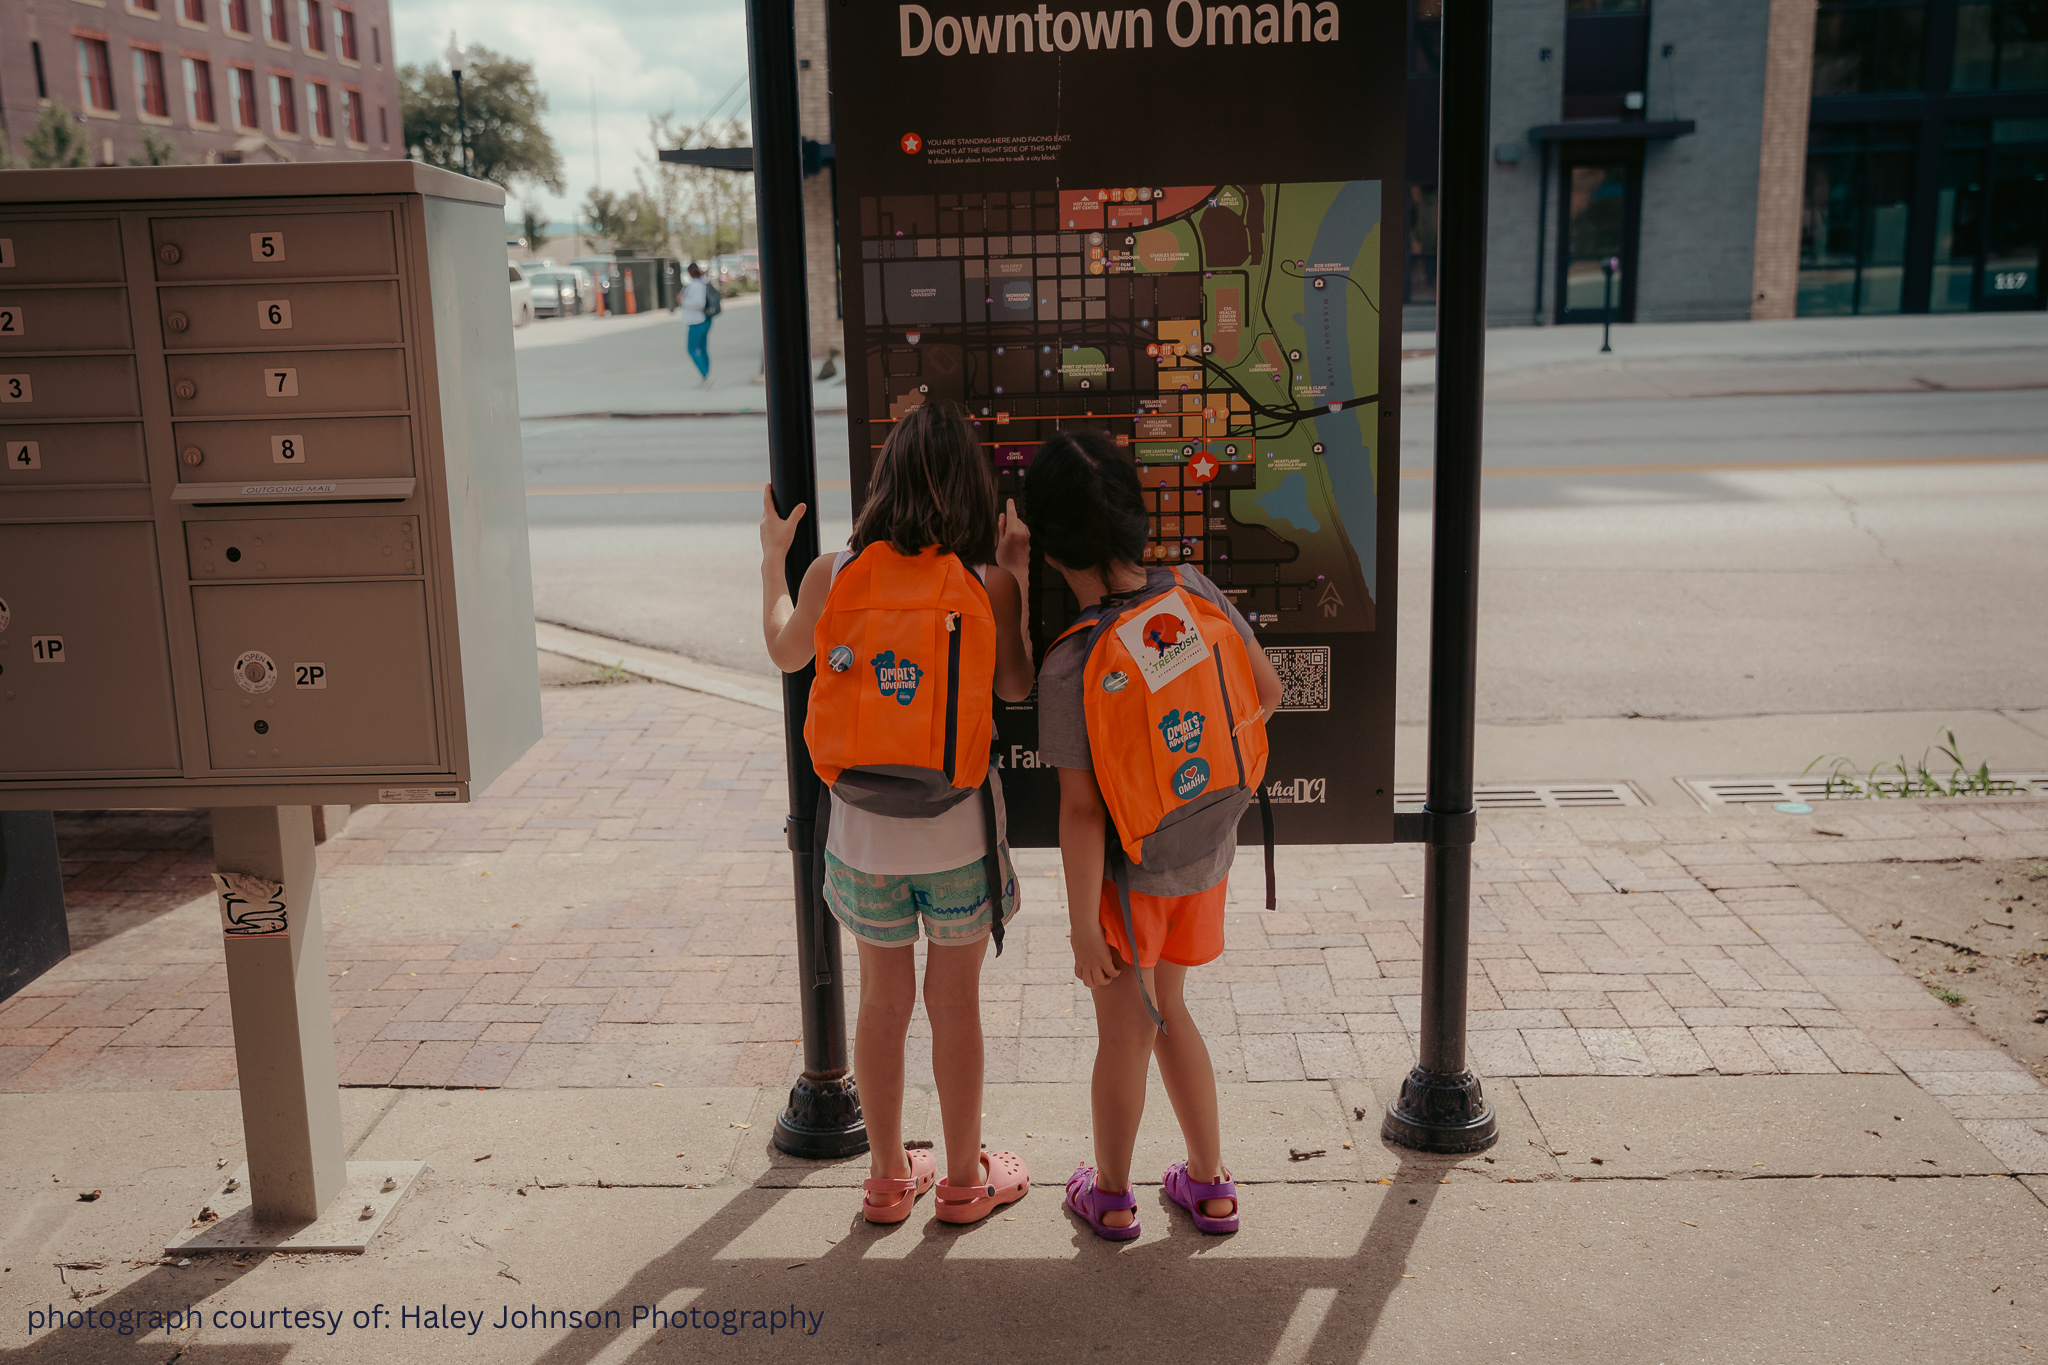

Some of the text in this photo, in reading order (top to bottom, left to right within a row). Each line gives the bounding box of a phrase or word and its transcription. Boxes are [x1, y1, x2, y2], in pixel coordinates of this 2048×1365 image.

[900, 0, 1340, 57] Downtown Omaha
[957, 137, 991, 145] STANDING
[1031, 154, 1041, 163] city
[261, 237, 275, 258] 5
[0, 311, 15, 332] 2
[268, 304, 282, 325] 6
[9, 378, 23, 399] 3
[274, 373, 287, 393] 7
[17, 446, 32, 466] 4
[281, 439, 295, 459] 8
[246, 484, 333, 494] OUTGOING MAIL
[1323, 604, 1338, 618] N
[33, 639, 63, 659] 1P
[243, 653, 266, 663] OPEN
[1152, 633, 1199, 672] TREERUSH
[296, 666, 324, 685] 2P
[880, 680, 916, 690] ADVENTURE
[1168, 727, 1201, 749] ADVENTURE
[1180, 773, 1185, 784] I
